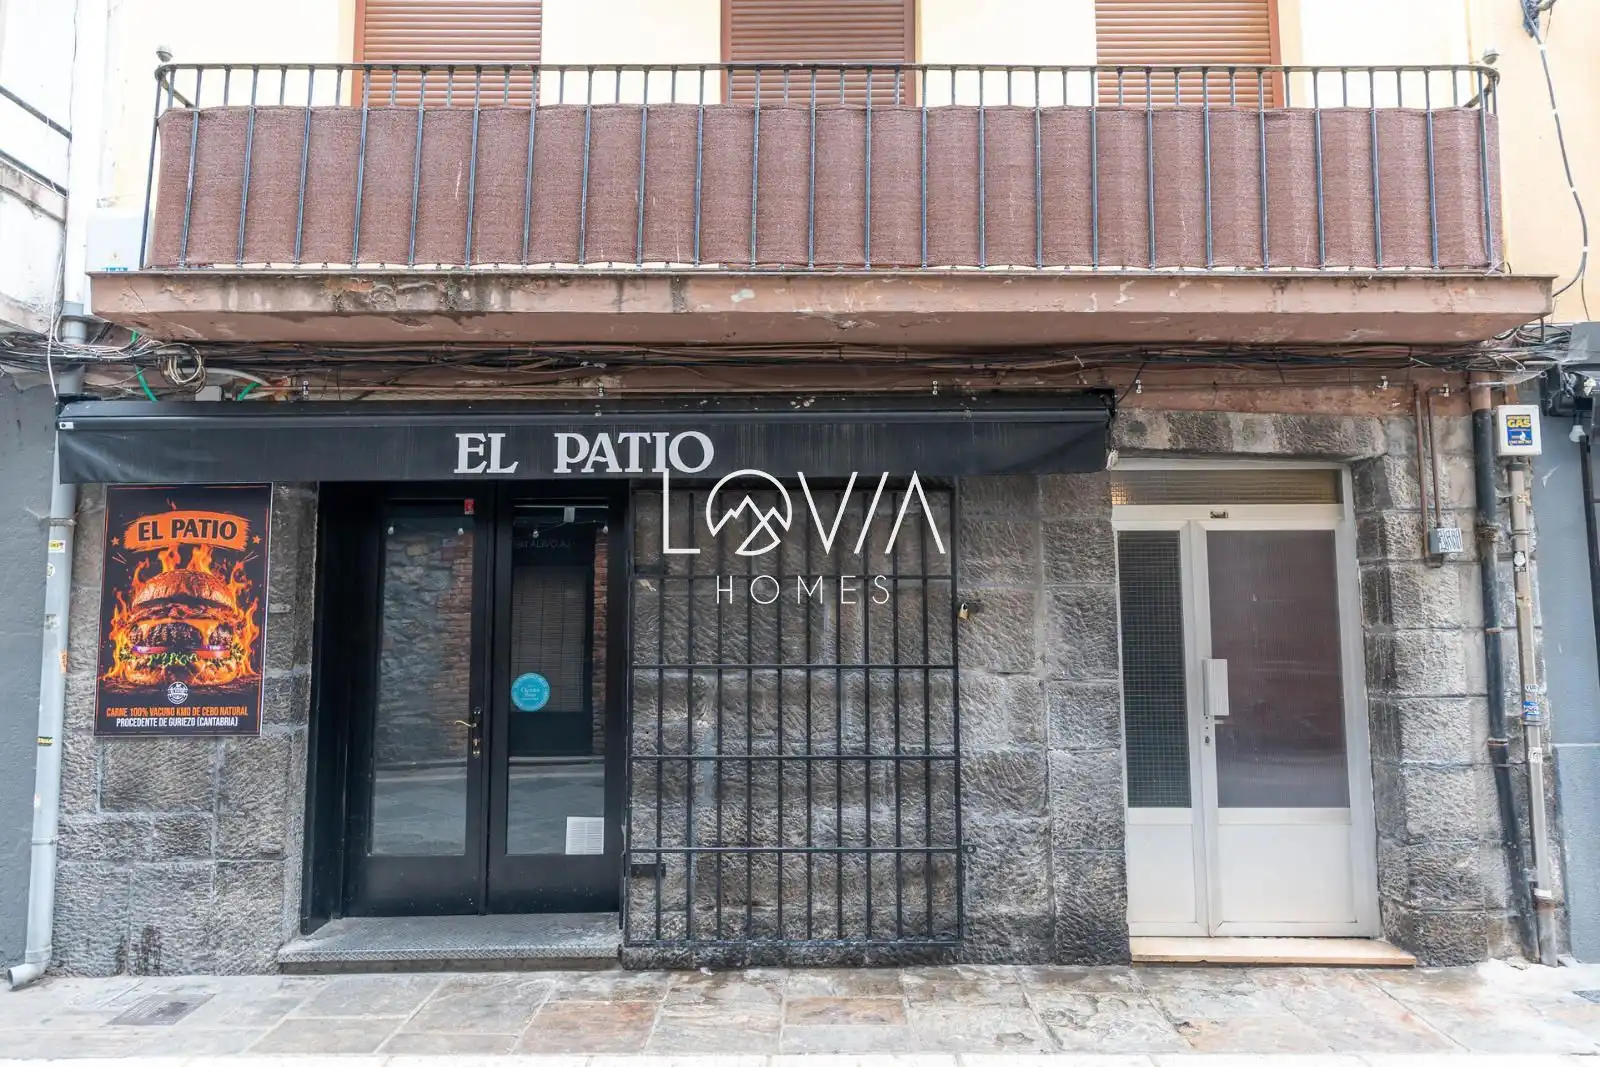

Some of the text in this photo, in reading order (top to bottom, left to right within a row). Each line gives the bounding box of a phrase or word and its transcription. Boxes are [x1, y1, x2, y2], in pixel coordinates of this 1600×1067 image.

[1507, 418, 1531, 428] GAS
[453, 430, 715, 474] EL PATIO
[137, 518, 238, 542] EL PATIO
[106, 707, 128, 717] CARNE
[130, 707, 148, 717] 100%
[149, 706, 175, 717] VACUNO
[192, 706, 200, 716] DE
[202, 706, 219, 716] CEBO
[220, 705, 248, 716] NATURAL
[116, 717, 238, 727] PROCEDENTE DE GURIEZO (CANTABRIA)
